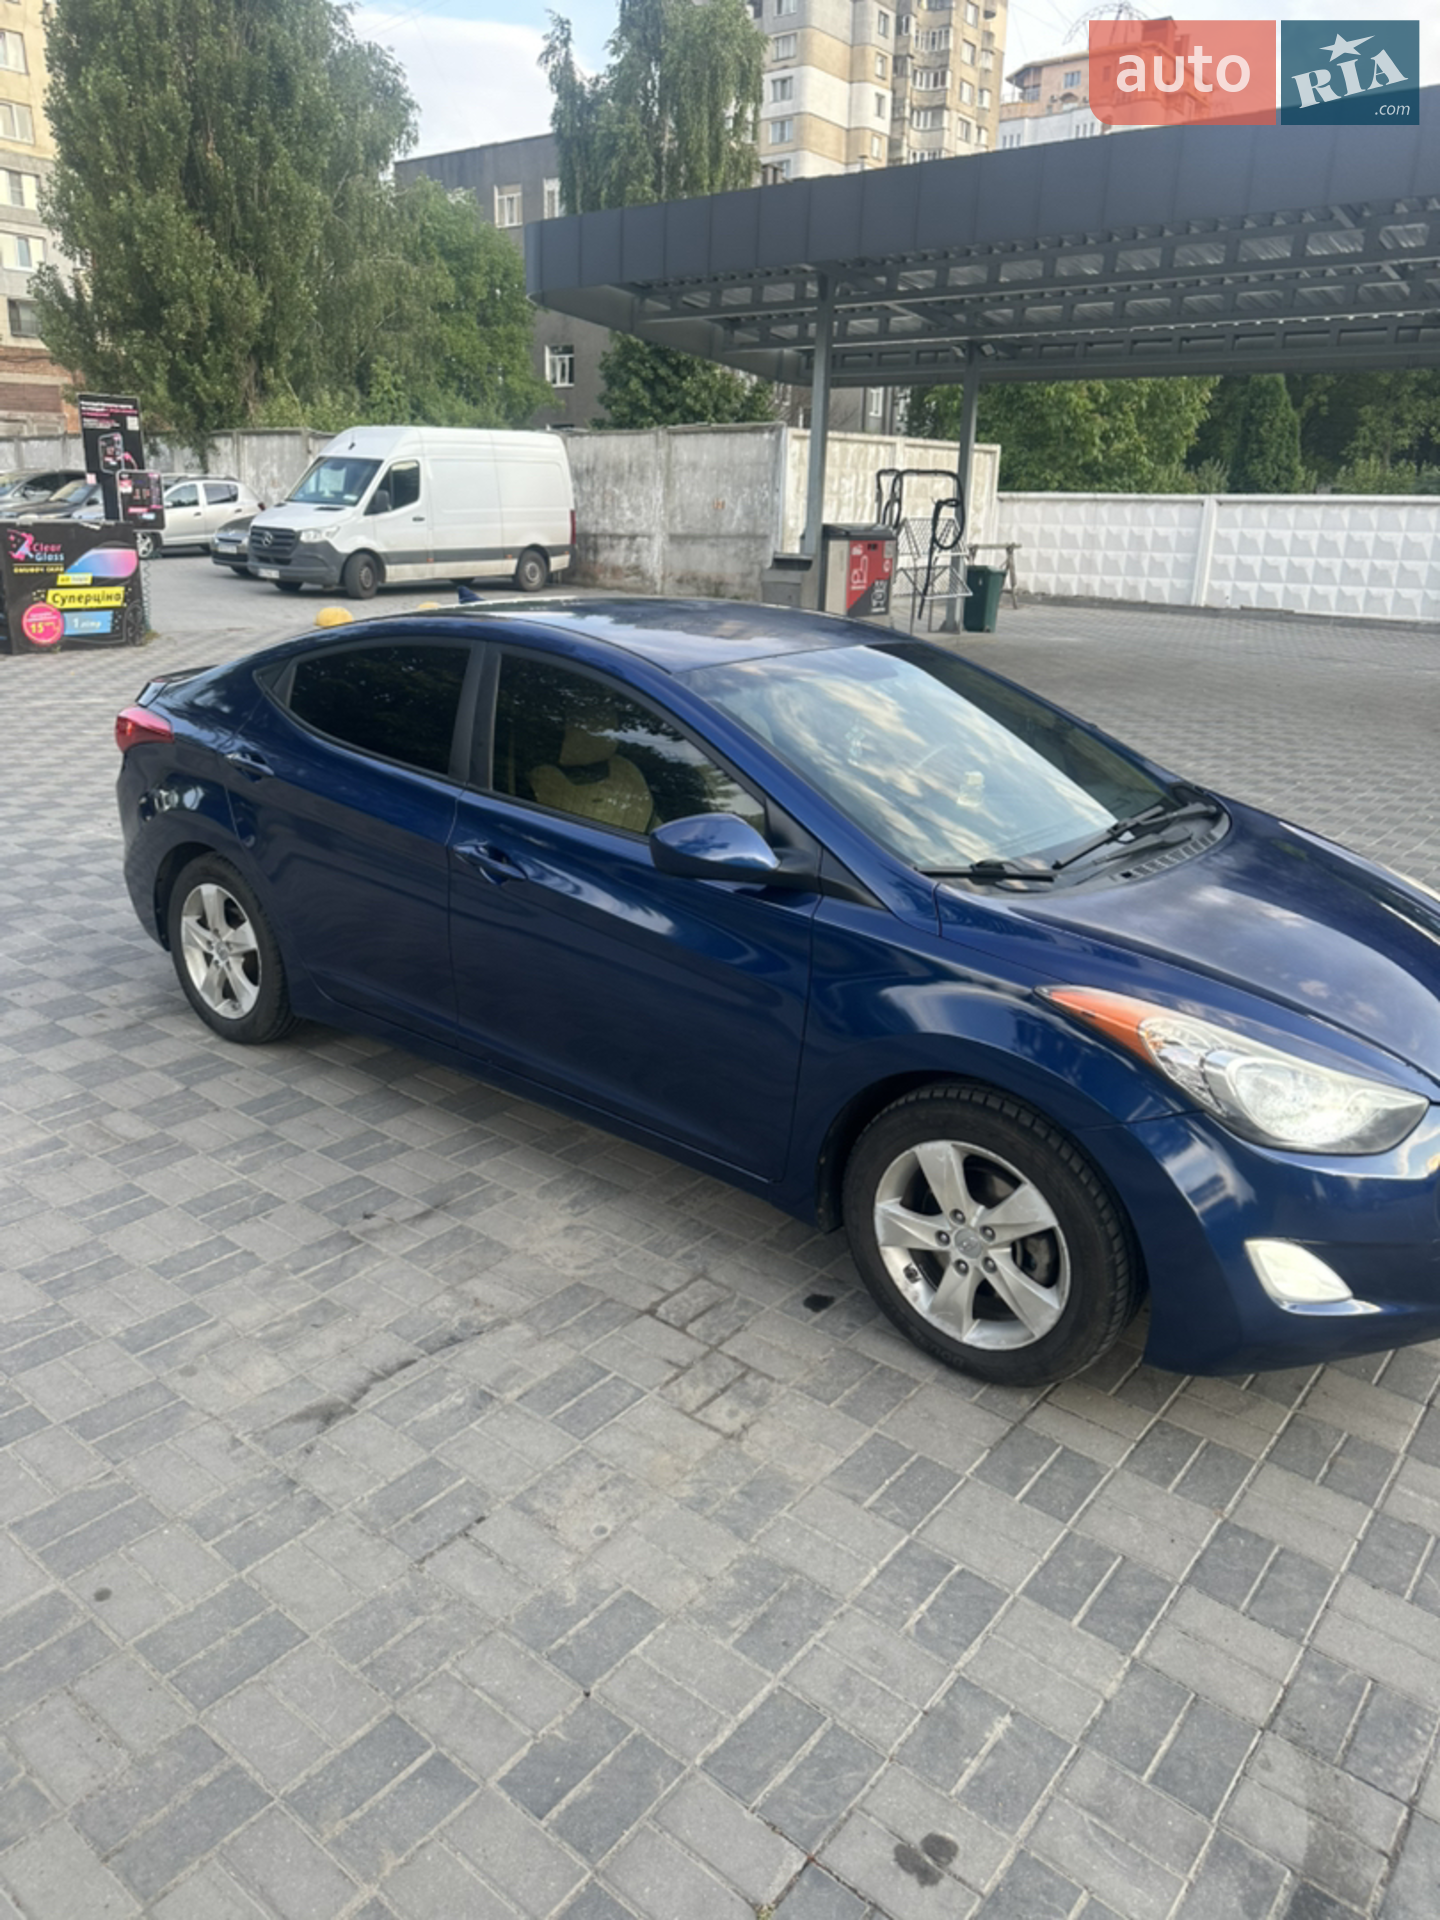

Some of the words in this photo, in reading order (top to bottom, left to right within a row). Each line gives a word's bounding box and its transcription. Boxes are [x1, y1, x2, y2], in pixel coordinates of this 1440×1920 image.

[33, 543, 61, 551] Clear
[52, 591, 121, 606] Суперціна
[73, 617, 79, 629] 1
